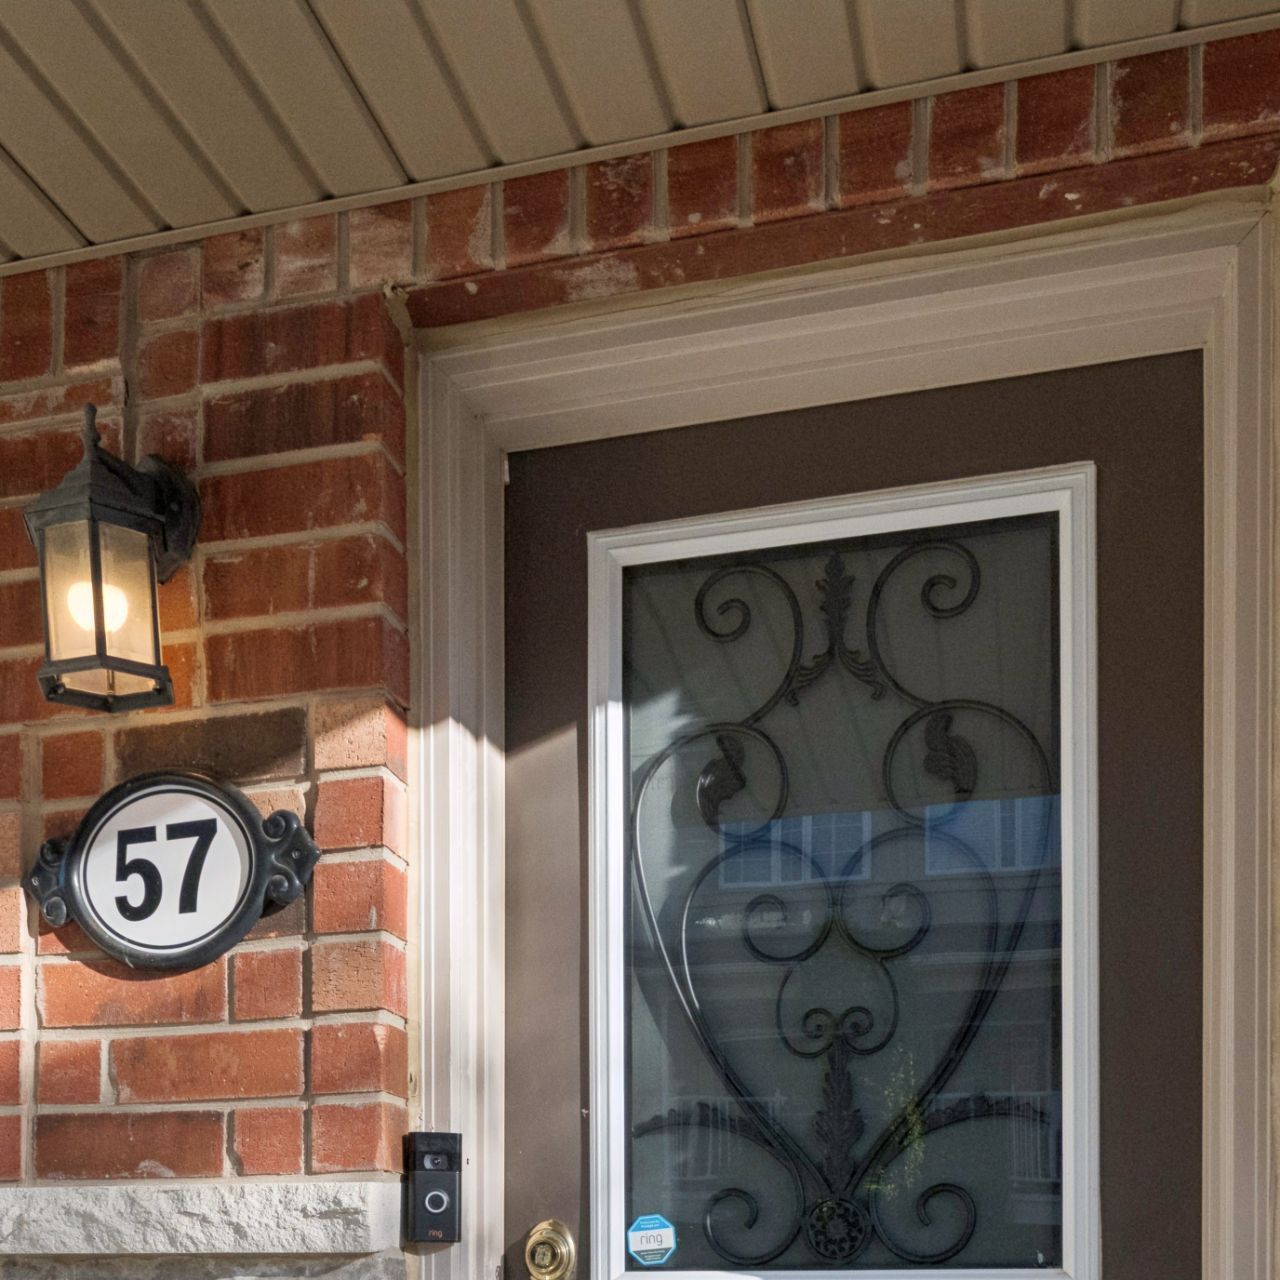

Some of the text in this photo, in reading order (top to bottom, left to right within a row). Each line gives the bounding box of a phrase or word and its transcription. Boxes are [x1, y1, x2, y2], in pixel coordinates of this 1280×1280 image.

[114, 817, 218, 922] 57
[428, 1229, 443, 1239] ring
[640, 1231, 663, 1247] ring
